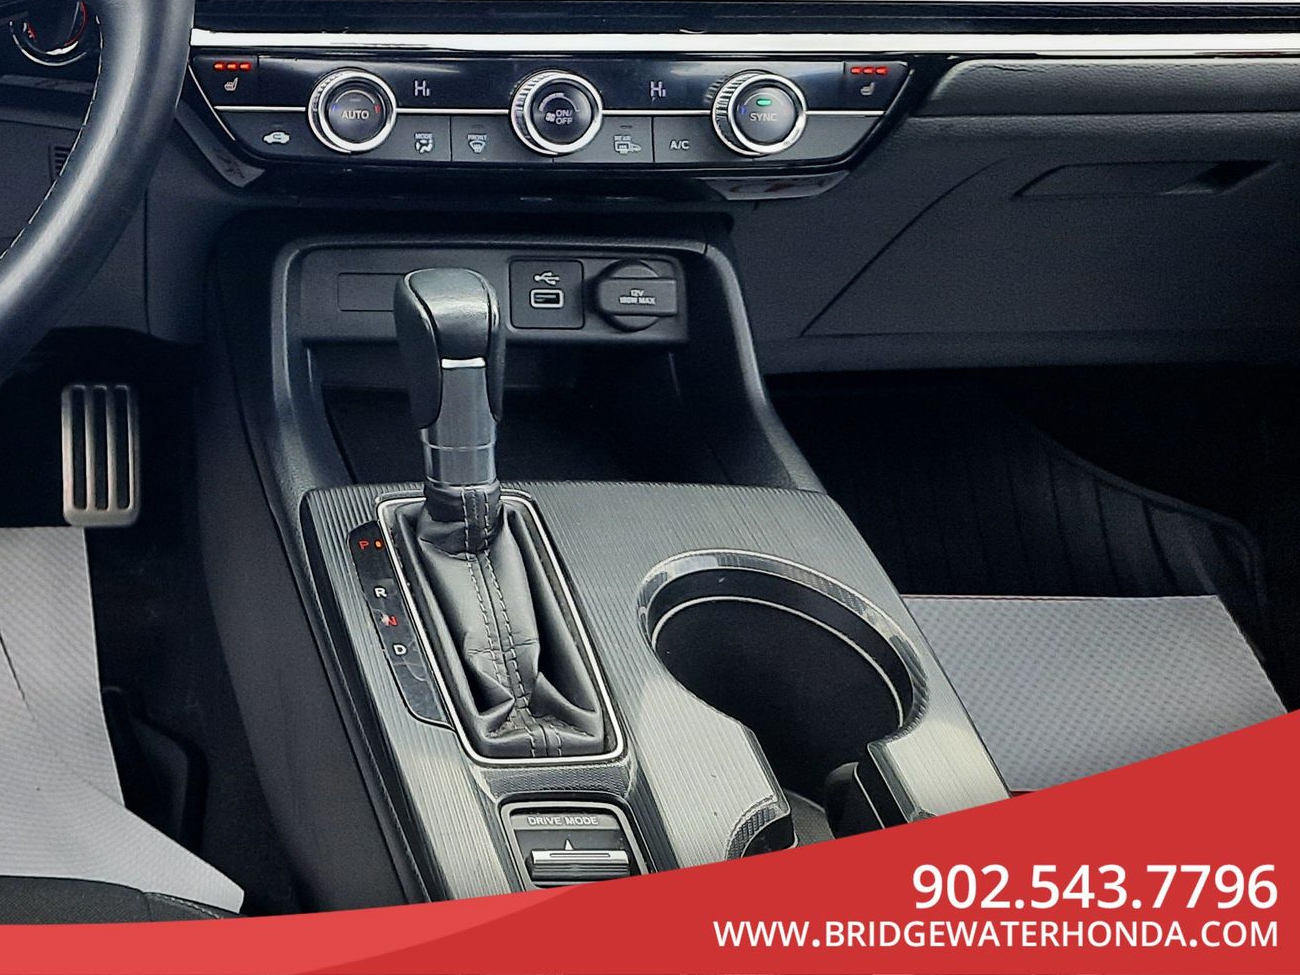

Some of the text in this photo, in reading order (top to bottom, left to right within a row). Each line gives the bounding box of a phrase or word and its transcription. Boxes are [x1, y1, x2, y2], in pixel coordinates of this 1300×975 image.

[341, 109, 370, 120] AUTO
[749, 113, 778, 122] SYNC
[555, 117, 573, 125] OFF
[670, 140, 689, 150] A/C
[359, 540, 369, 550] P
[374, 587, 387, 598] R
[393, 644, 406, 655] D
[527, 815, 599, 826] DRIVE MODE
